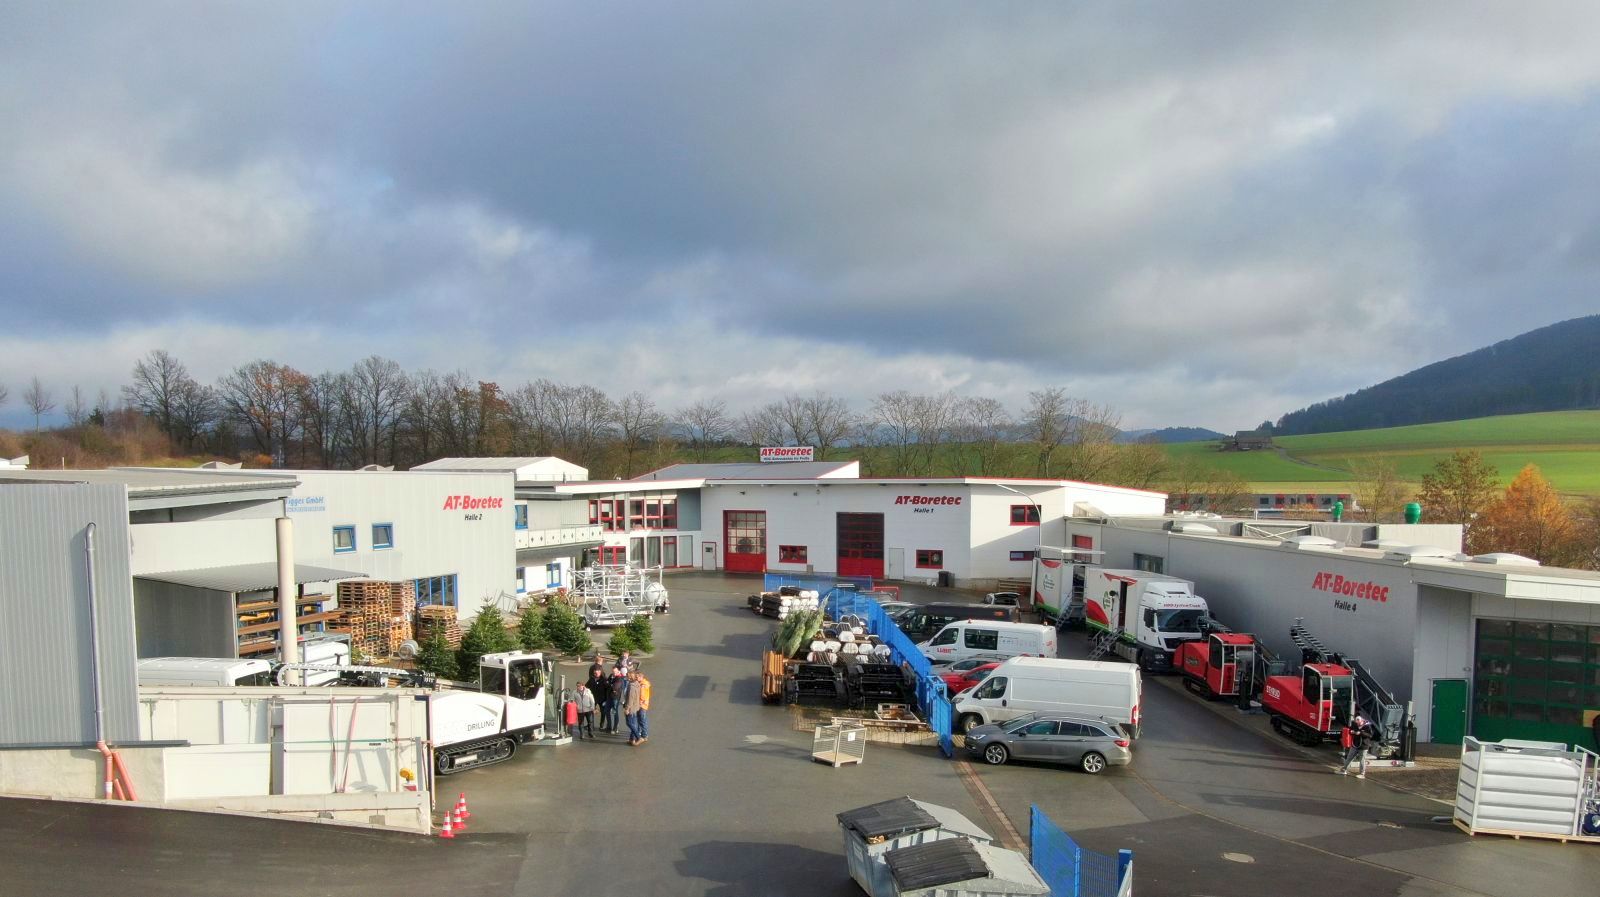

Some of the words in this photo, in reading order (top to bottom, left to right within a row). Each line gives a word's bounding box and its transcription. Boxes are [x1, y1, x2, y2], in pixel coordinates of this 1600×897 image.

[761, 448, 812, 456] AT-Boretec
[305, 496, 324, 504] GmbH
[443, 495, 503, 510] AT-Boretec
[895, 495, 962, 505] AT-Boretec
[1312, 571, 1389, 602] AT-Boretec
[1334, 599, 1351, 611] Halle
[1351, 603, 1357, 612] 4
[467, 719, 495, 731] DRILLING
